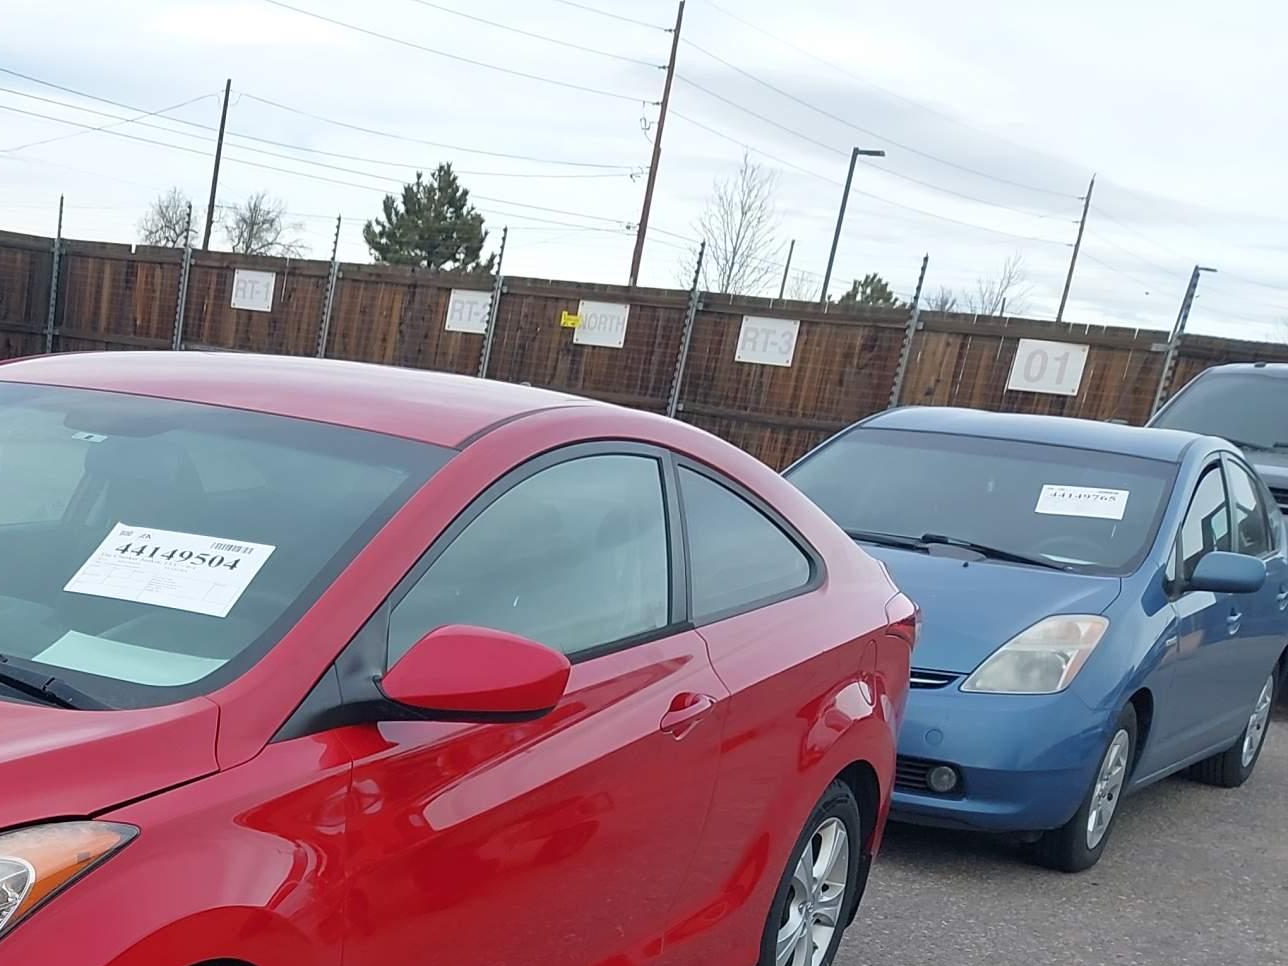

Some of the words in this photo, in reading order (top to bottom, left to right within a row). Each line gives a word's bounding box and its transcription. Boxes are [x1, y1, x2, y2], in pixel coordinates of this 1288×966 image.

[235, 279, 270, 301] RT-1
[741, 326, 794, 355] RT-3
[1023, 349, 1071, 385] 01
[114, 542, 242, 571] 44149504
